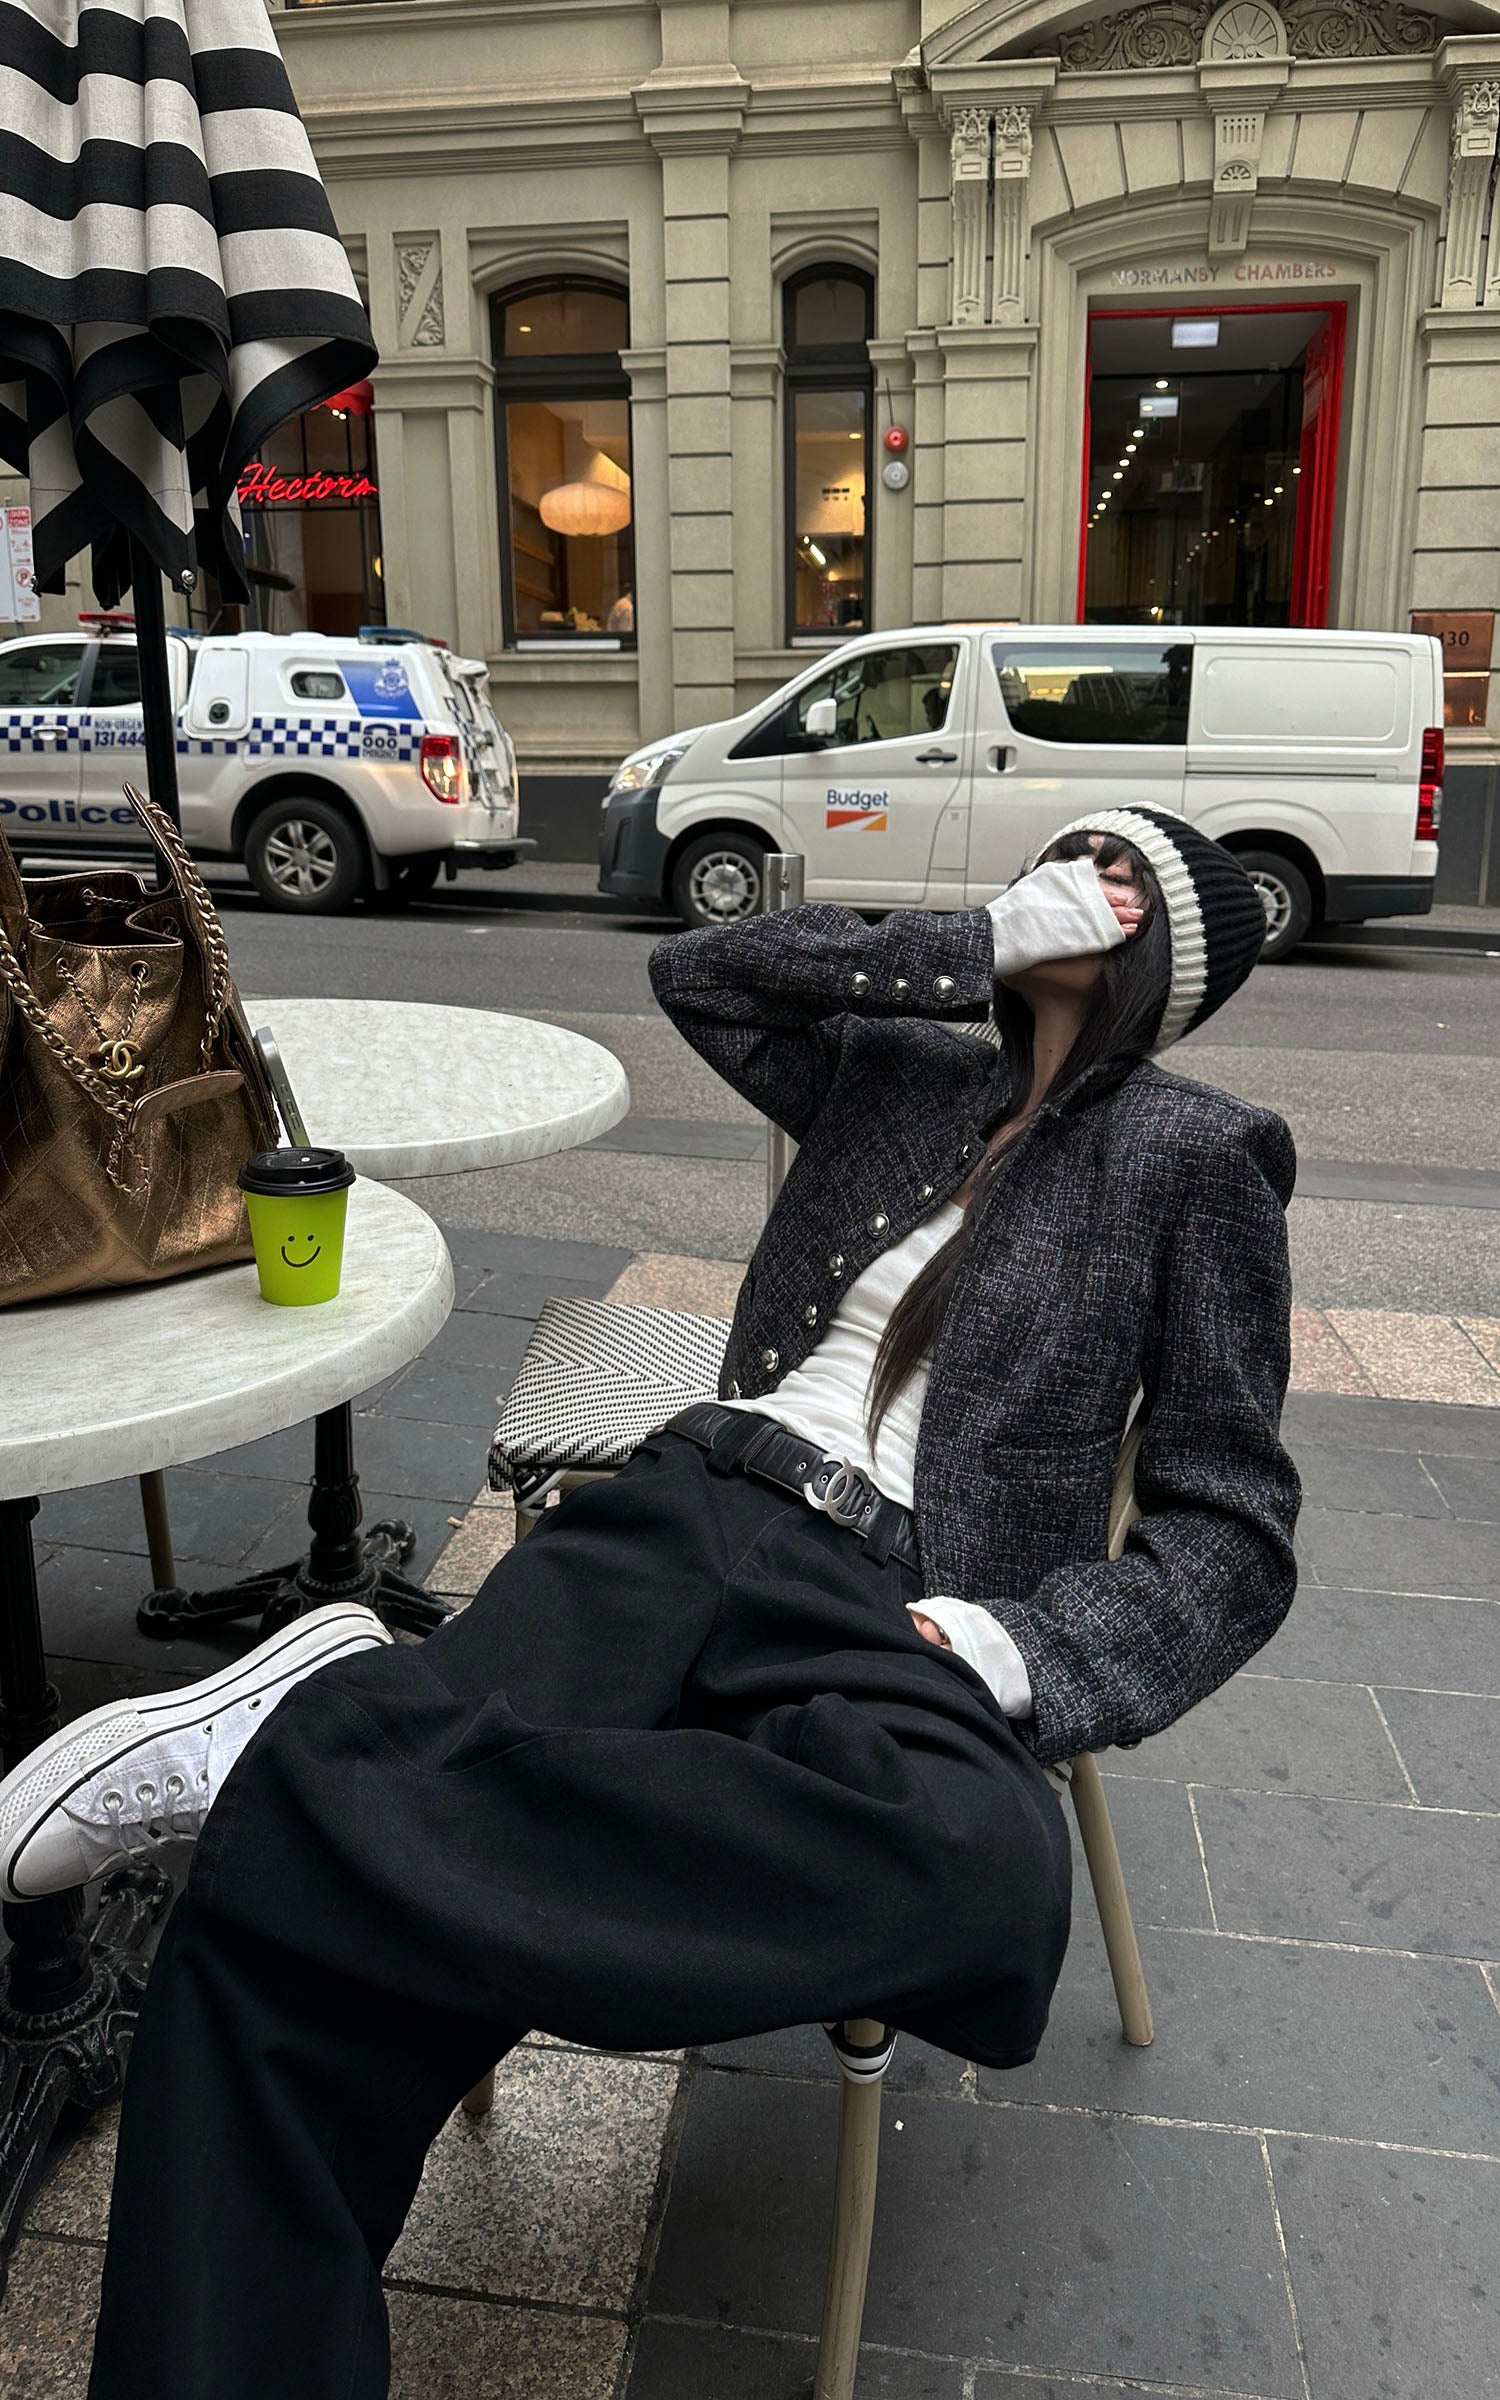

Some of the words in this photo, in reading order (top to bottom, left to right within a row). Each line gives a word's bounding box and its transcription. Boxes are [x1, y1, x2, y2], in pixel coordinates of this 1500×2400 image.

[1112, 266, 1220, 287] NORMANBY
[1234, 262, 1337, 281] CHAMBERS
[826, 789, 888, 810] Budget
